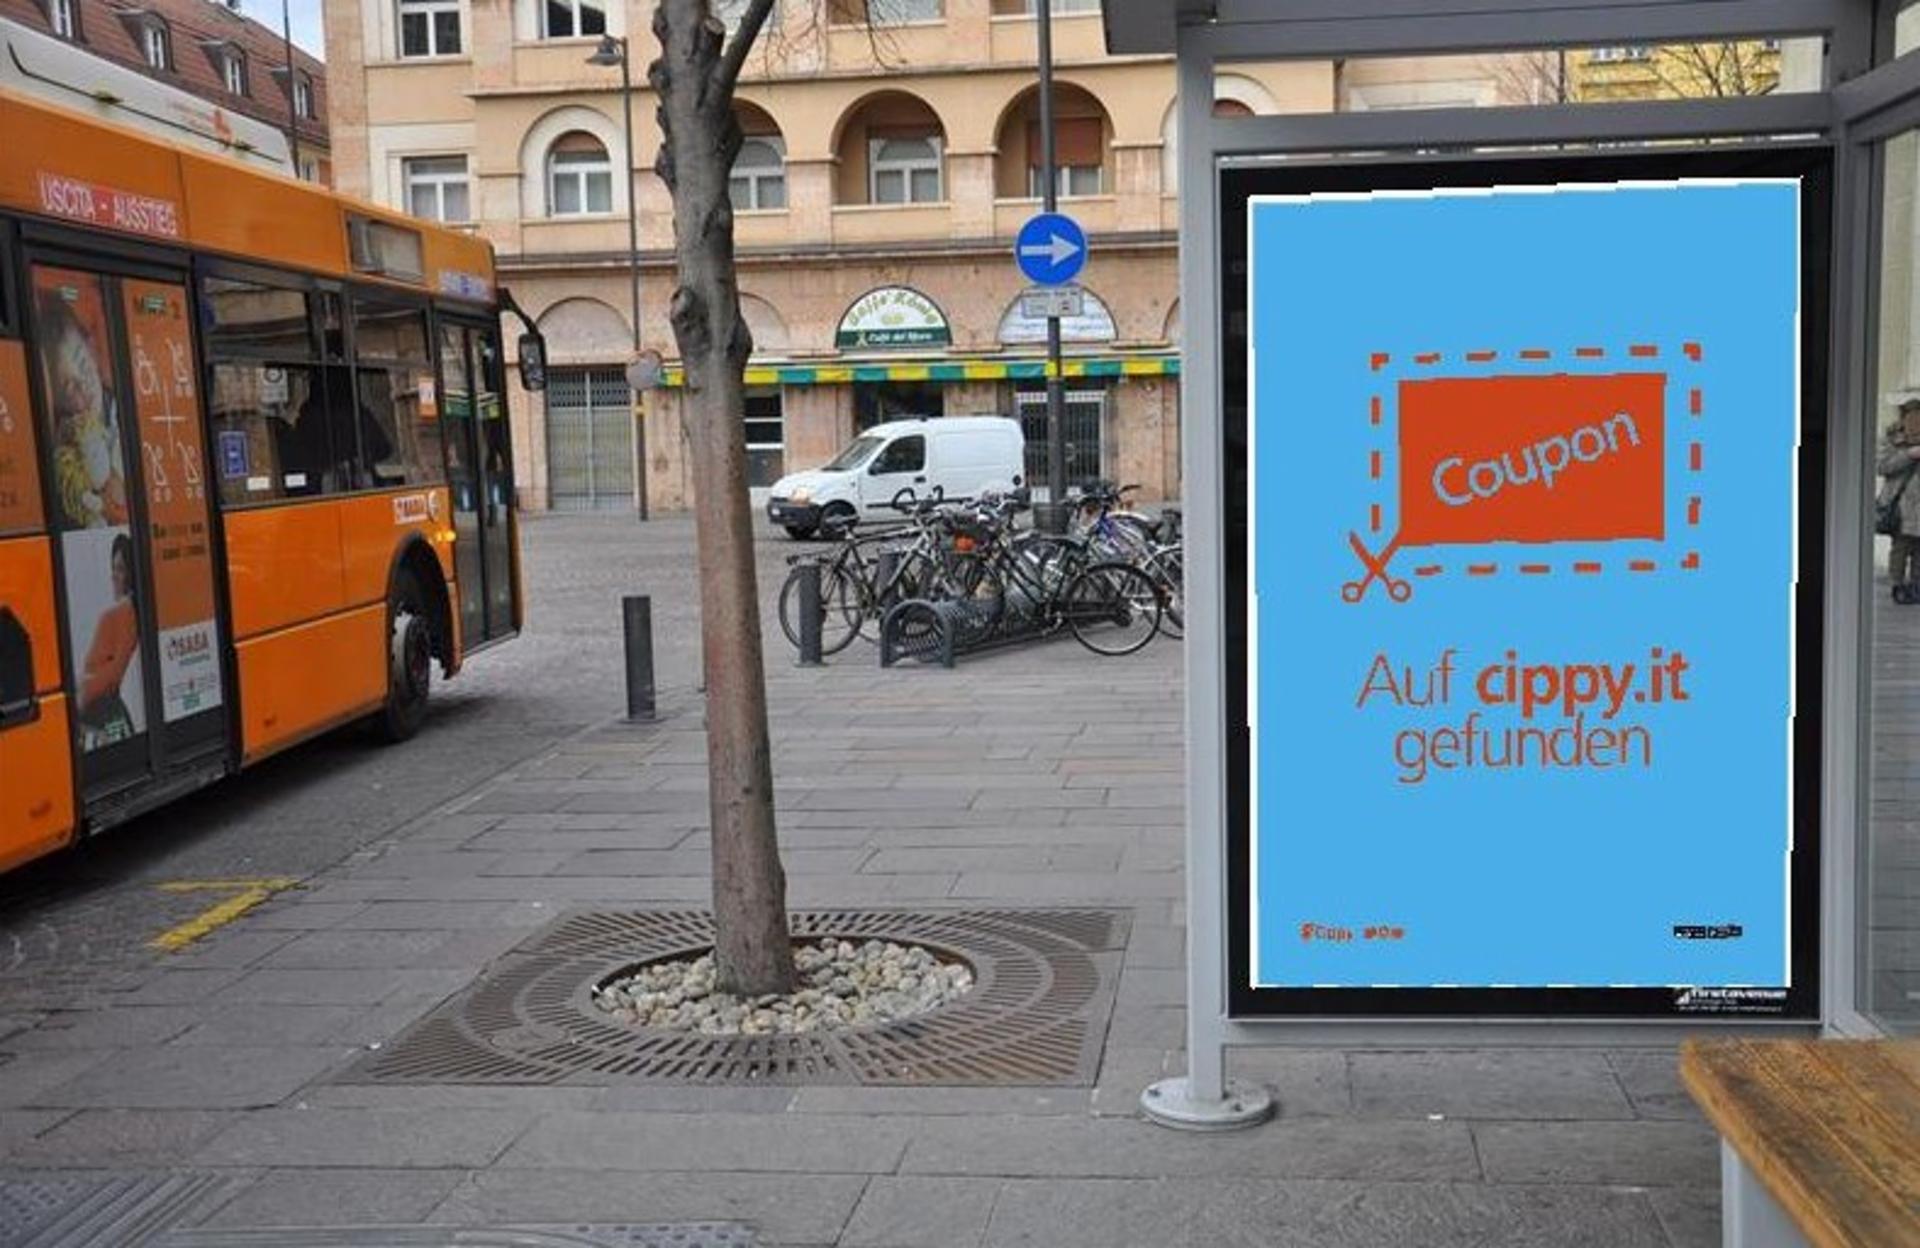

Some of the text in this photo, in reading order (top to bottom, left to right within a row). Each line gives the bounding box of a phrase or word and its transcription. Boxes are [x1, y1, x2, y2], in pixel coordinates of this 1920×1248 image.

[38, 173, 97, 222] USCITA
[1432, 411, 1641, 506] Coupon
[1356, 646, 1691, 720] Auf cippy.it
[1393, 710, 1653, 785] gefunden
